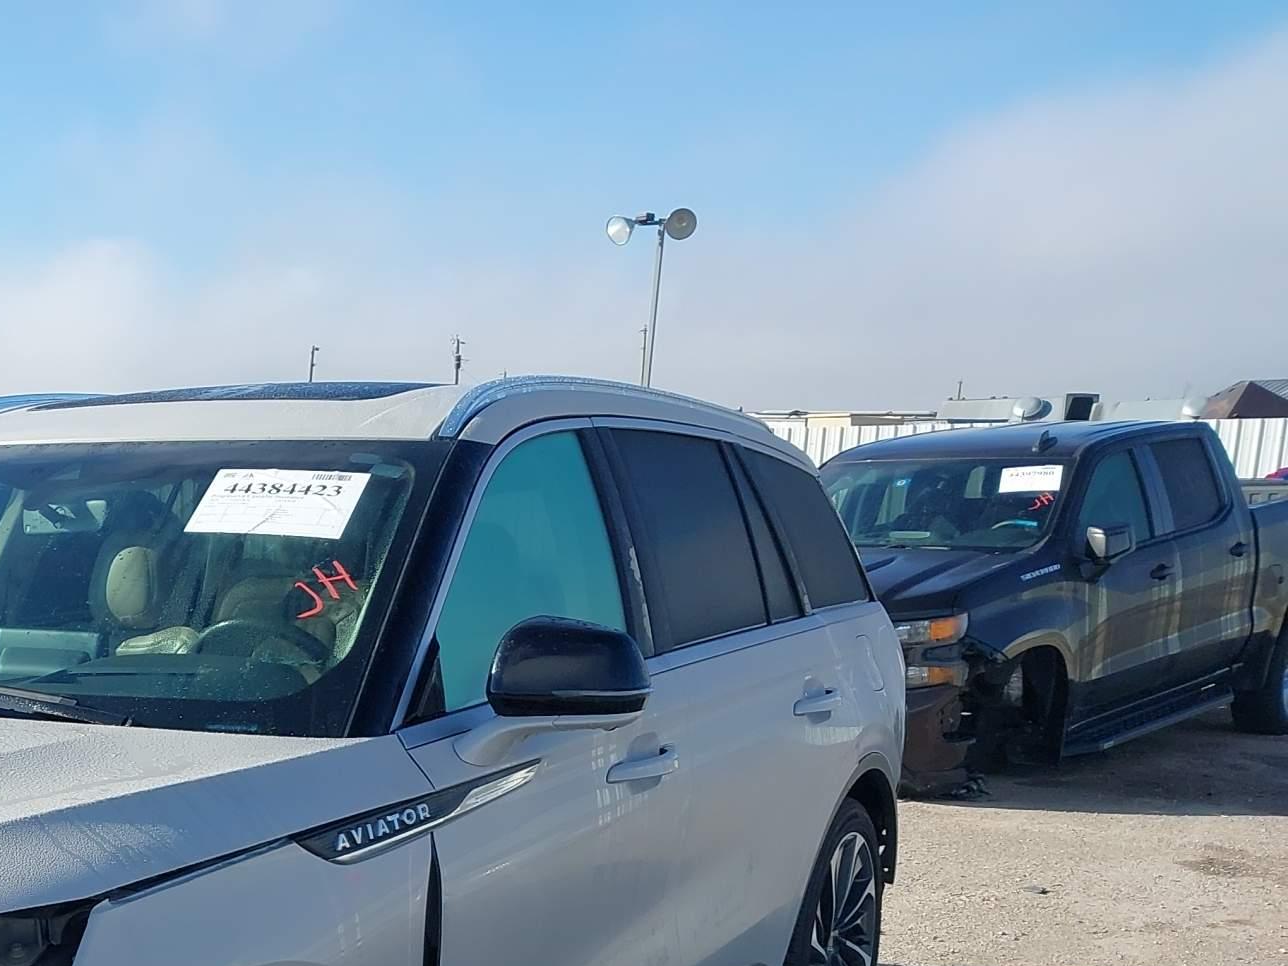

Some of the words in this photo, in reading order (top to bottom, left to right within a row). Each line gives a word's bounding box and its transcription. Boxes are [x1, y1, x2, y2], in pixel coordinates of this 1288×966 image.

[223, 481, 344, 498] 44384423
[294, 560, 358, 619] JH
[336, 803, 431, 851] AVIATOR
